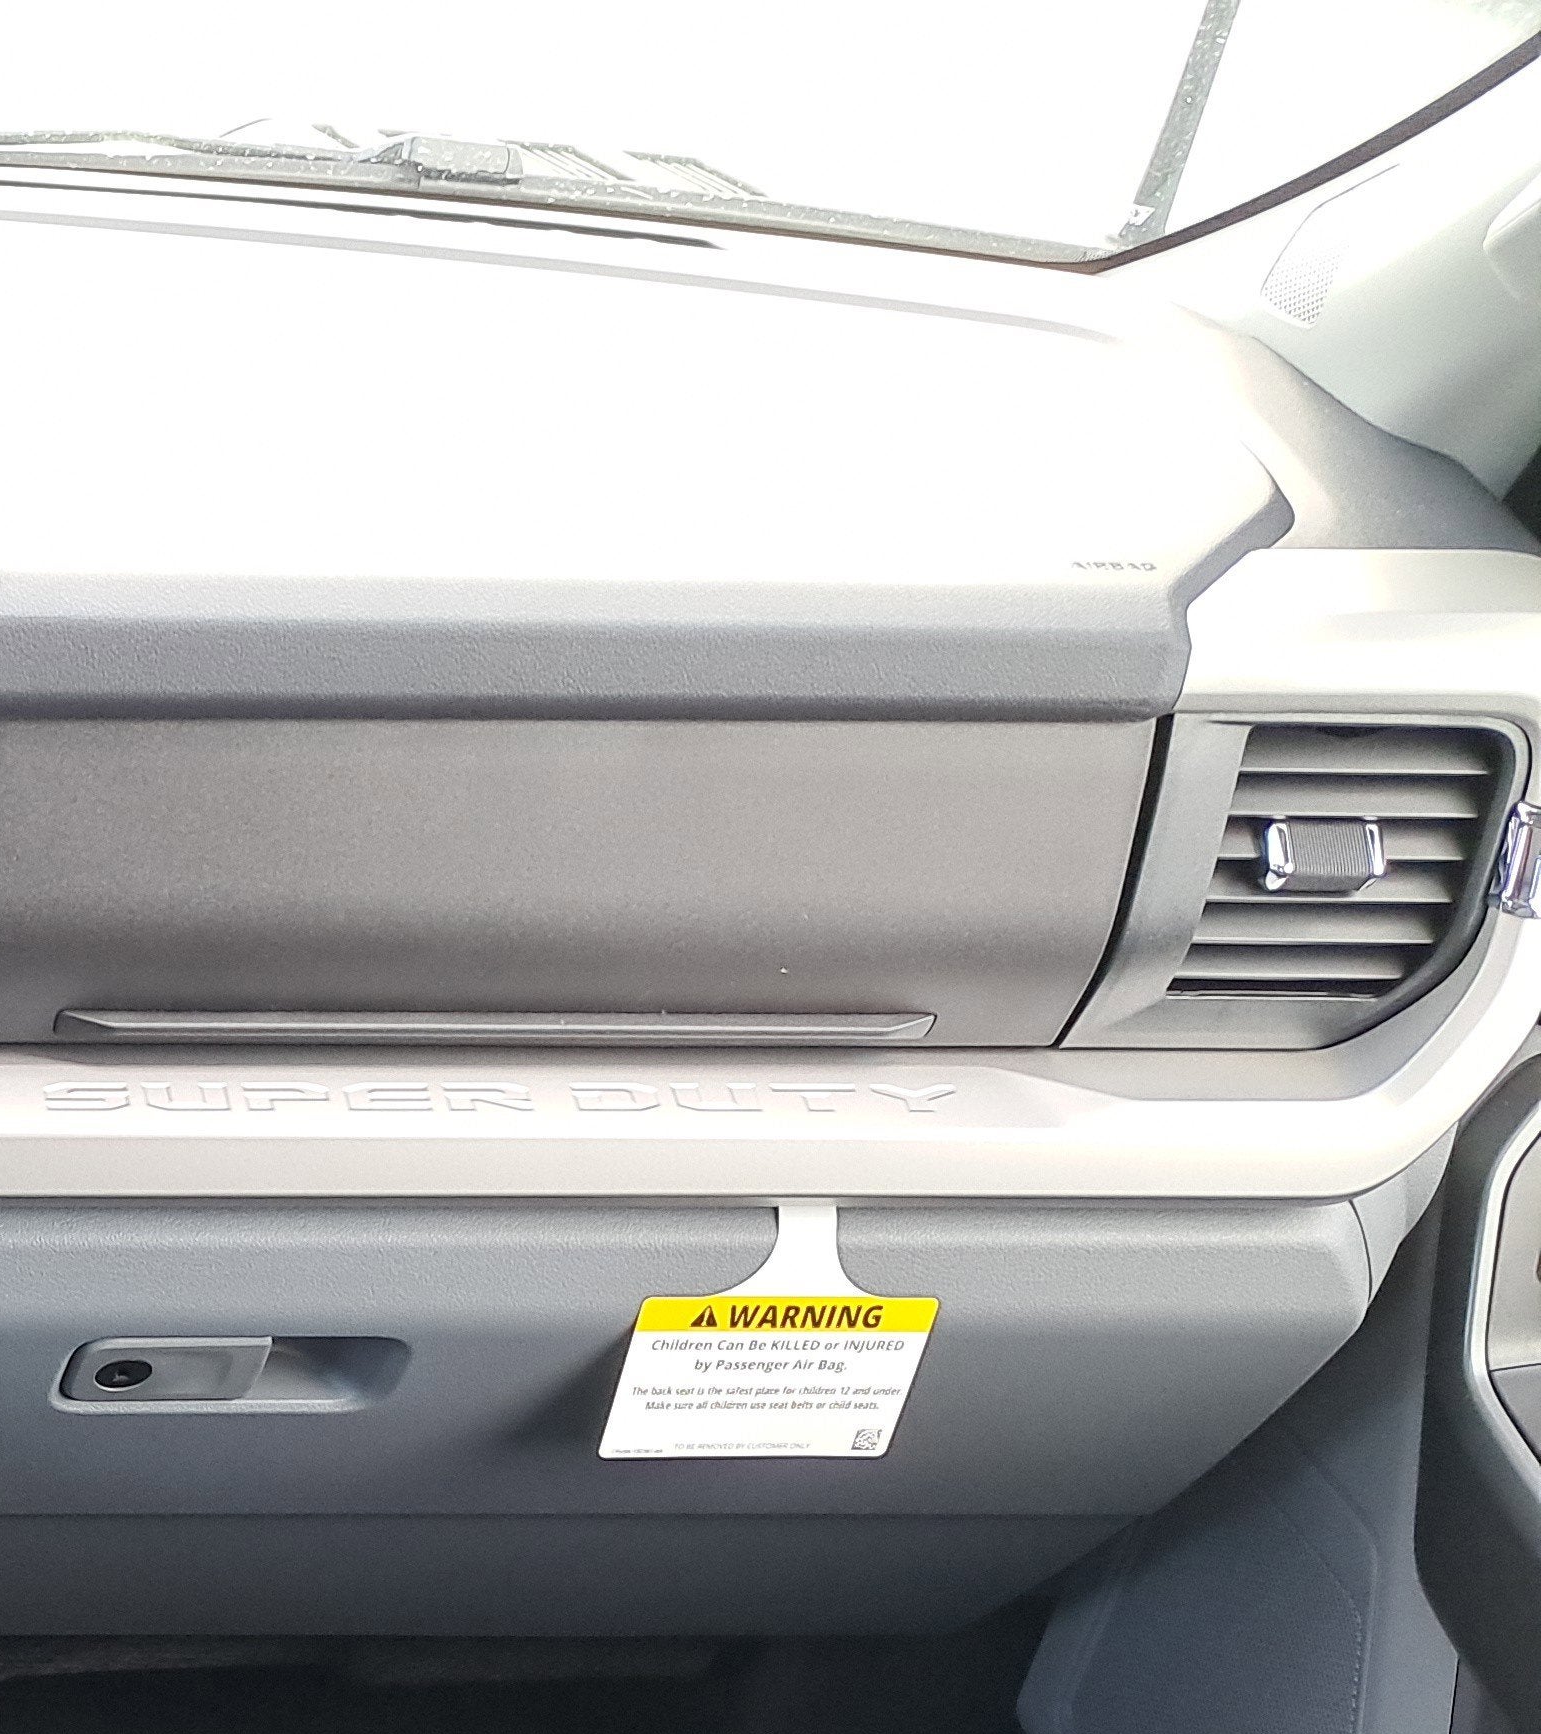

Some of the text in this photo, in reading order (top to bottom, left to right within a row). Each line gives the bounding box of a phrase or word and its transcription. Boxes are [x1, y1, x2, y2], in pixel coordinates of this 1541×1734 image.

[41, 1080, 959, 1114] SUPER DUTY
[729, 1304, 884, 1329] WARNING
[651, 1339, 905, 1354] Children Can Be KILLED or INJURED
[694, 1359, 848, 1373] by Passenger Air Bag.
[632, 1386, 902, 1396] The back seat is the safest place for children 12 and under.
[645, 1400, 879, 1410] Make sure all children use seat belts or child seats.
